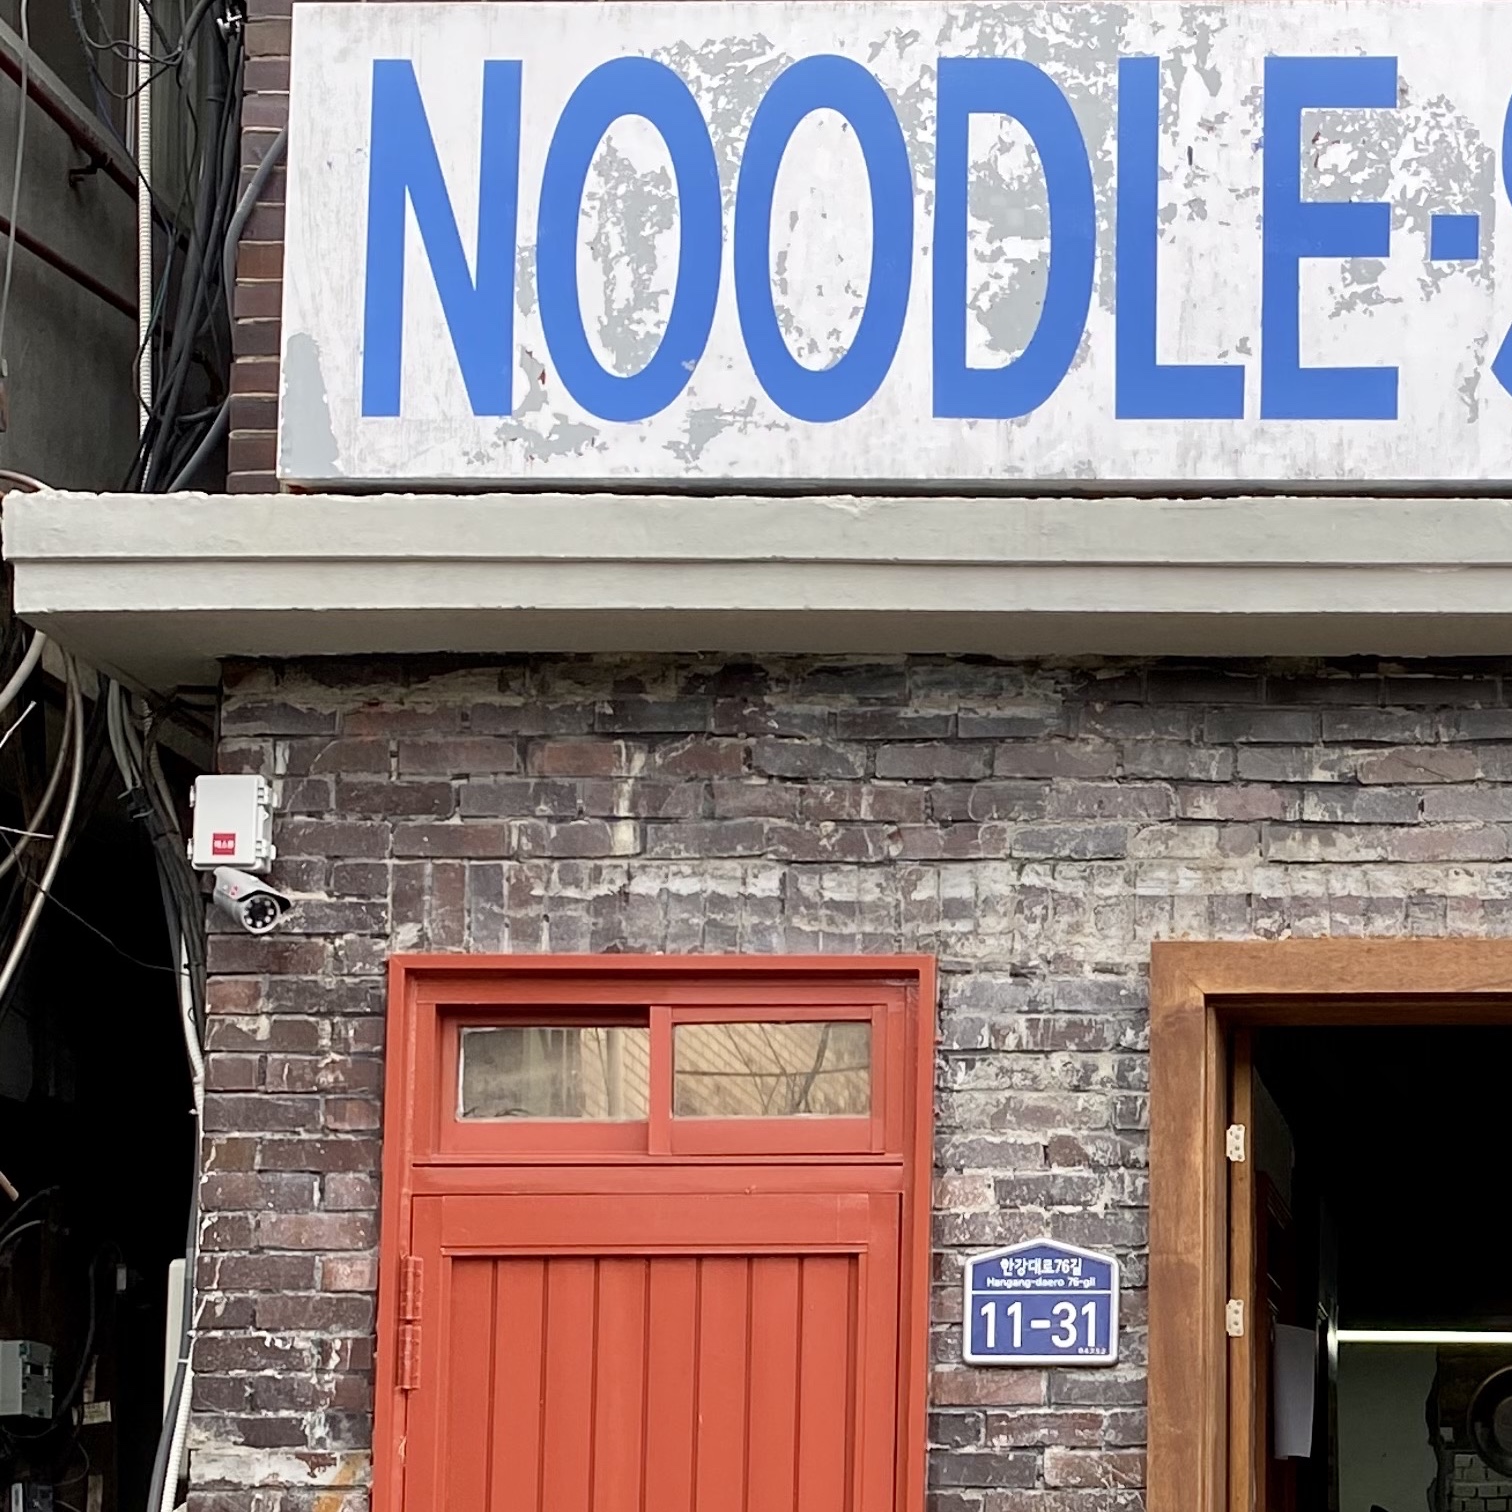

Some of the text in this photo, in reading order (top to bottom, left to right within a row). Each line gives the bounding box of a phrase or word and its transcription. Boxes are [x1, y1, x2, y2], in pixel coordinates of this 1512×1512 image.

[986, 1276, 1096, 1289] Hangang-daero 76-gil
[980, 1301, 1097, 1348] 11-31
